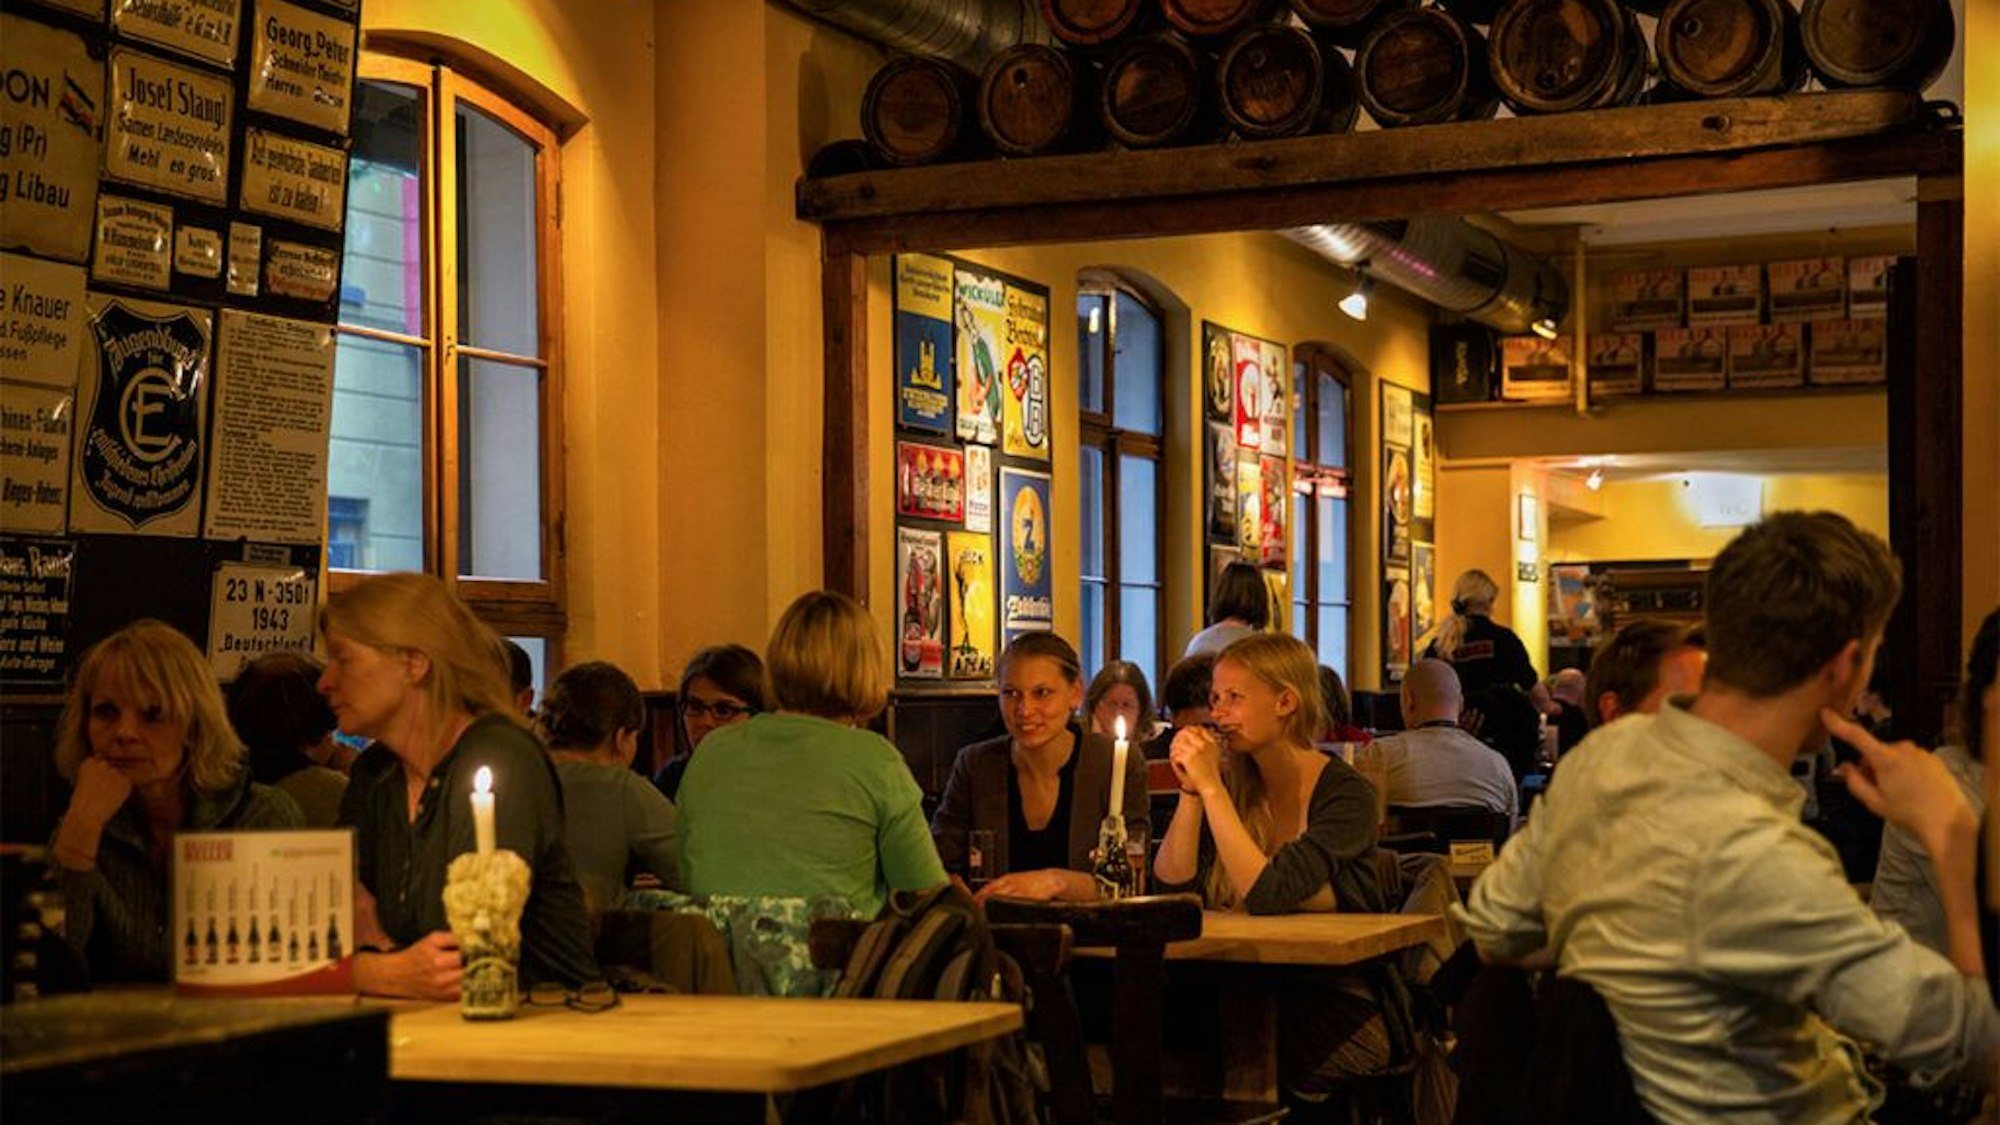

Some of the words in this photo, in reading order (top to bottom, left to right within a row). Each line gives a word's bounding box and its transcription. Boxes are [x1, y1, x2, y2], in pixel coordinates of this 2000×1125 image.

[265, 15, 312, 57] Georg
[122, 67, 173, 112] Josef
[178, 81, 227, 132] Stangl
[128, 143, 160, 169] Mehl
[16, 169, 70, 208] Libau
[12, 282, 71, 322] Knauer
[226, 578, 248, 602] 23
[252, 606, 290, 631] 1943
